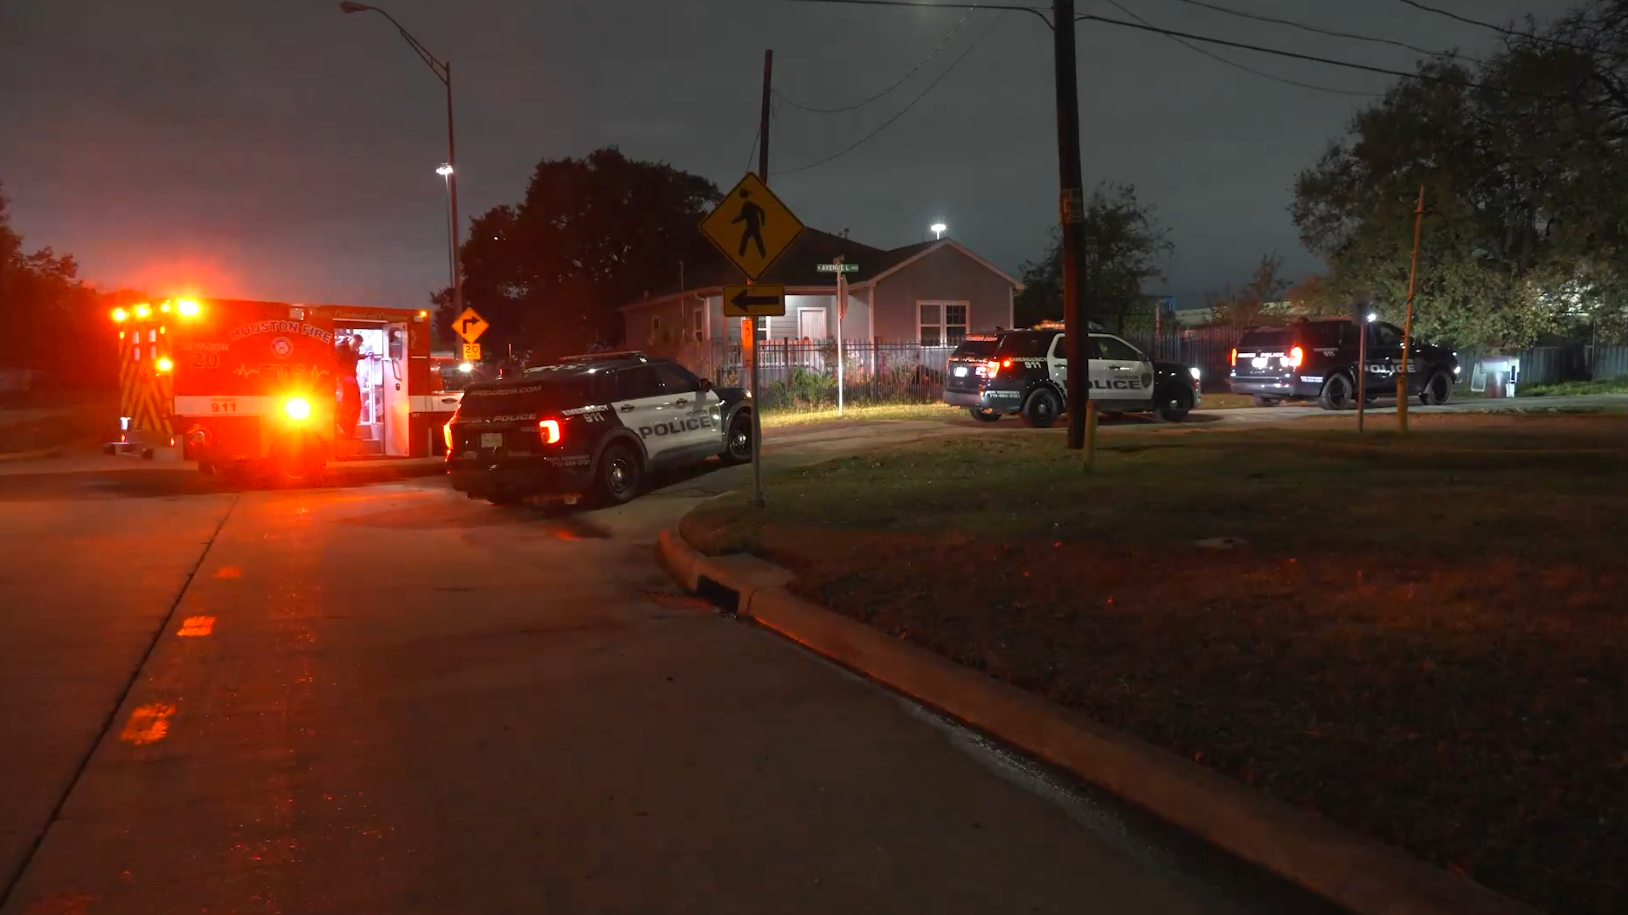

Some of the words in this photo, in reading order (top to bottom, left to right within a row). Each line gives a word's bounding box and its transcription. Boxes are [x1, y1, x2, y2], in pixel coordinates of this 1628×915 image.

[230, 320, 299, 341] HOUSTON
[301, 323, 333, 345] FIRE
[465, 345, 479, 354] 20
[190, 351, 219, 369] 20
[1024, 361, 1042, 369] 911
[211, 402, 236, 413] 911
[493, 413, 537, 423] POLICE
[583, 412, 605, 423] 911
[638, 415, 712, 439] POLICE
